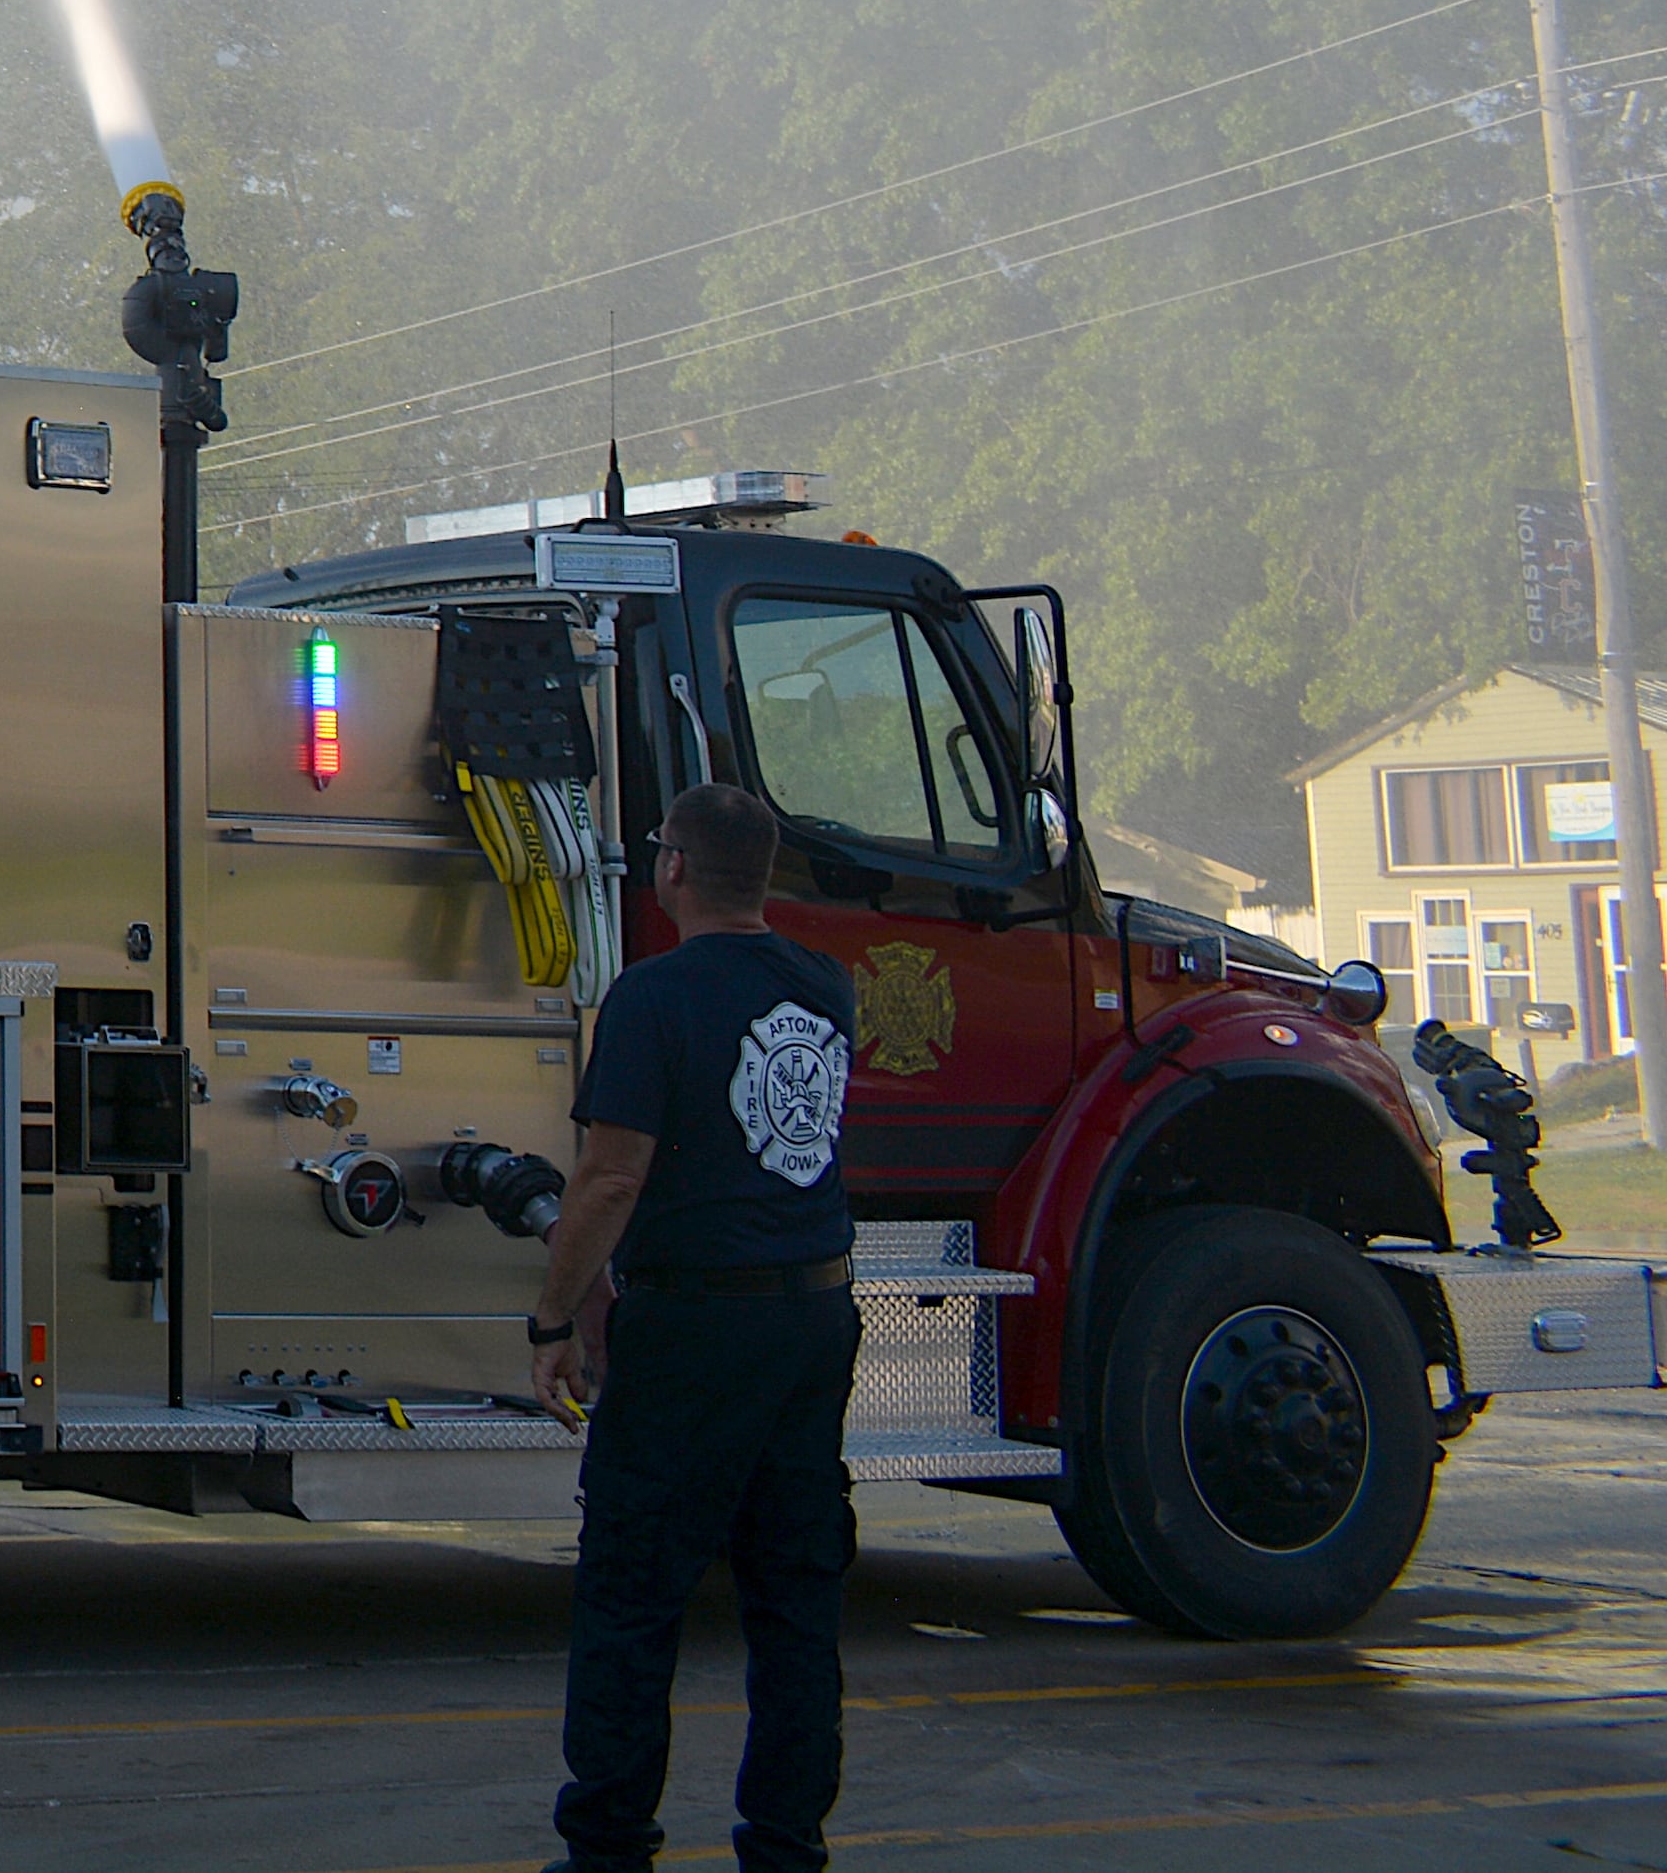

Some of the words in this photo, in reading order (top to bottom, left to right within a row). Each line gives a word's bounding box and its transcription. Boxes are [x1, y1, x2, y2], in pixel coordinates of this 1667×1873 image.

[1515, 503, 1545, 644] CRESTON
[1537, 923, 1563, 939] 405
[769, 1017, 819, 1038] AFTON
[746, 1061, 758, 1129] FIRE
[782, 1151, 822, 1171] IOWA
